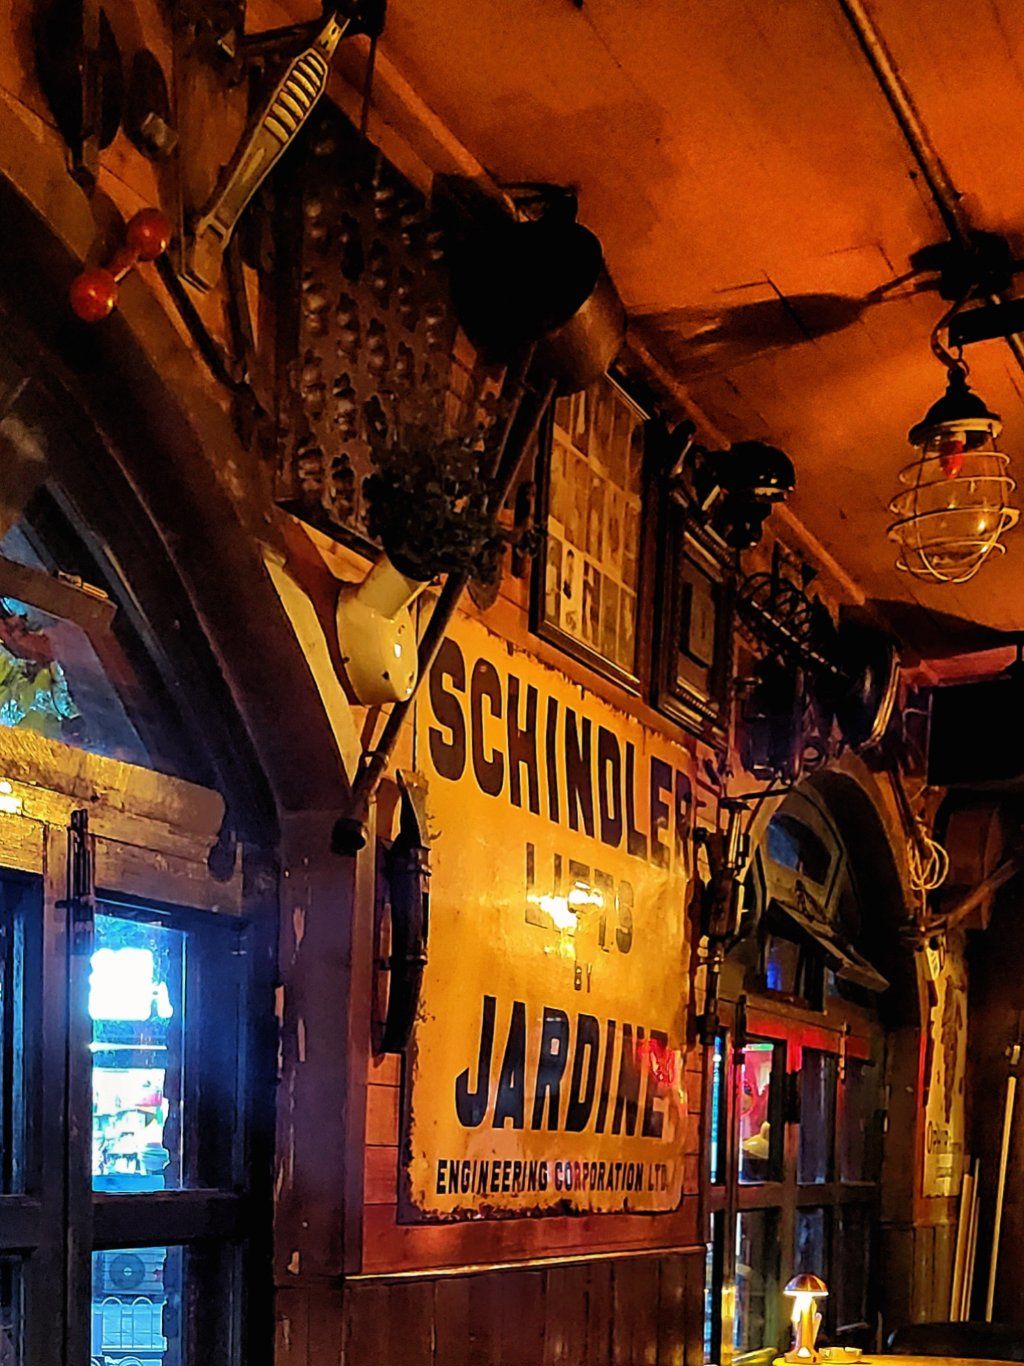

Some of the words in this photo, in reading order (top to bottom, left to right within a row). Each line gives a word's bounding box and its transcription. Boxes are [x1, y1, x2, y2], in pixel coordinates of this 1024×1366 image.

[429, 636, 693, 880] SCHINDLER
[574, 960, 593, 993] BY
[455, 994, 669, 1138] JARDINE
[436, 1159, 548, 1195] ENGINEERING
[554, 1160, 644, 1192] CORPORATION
